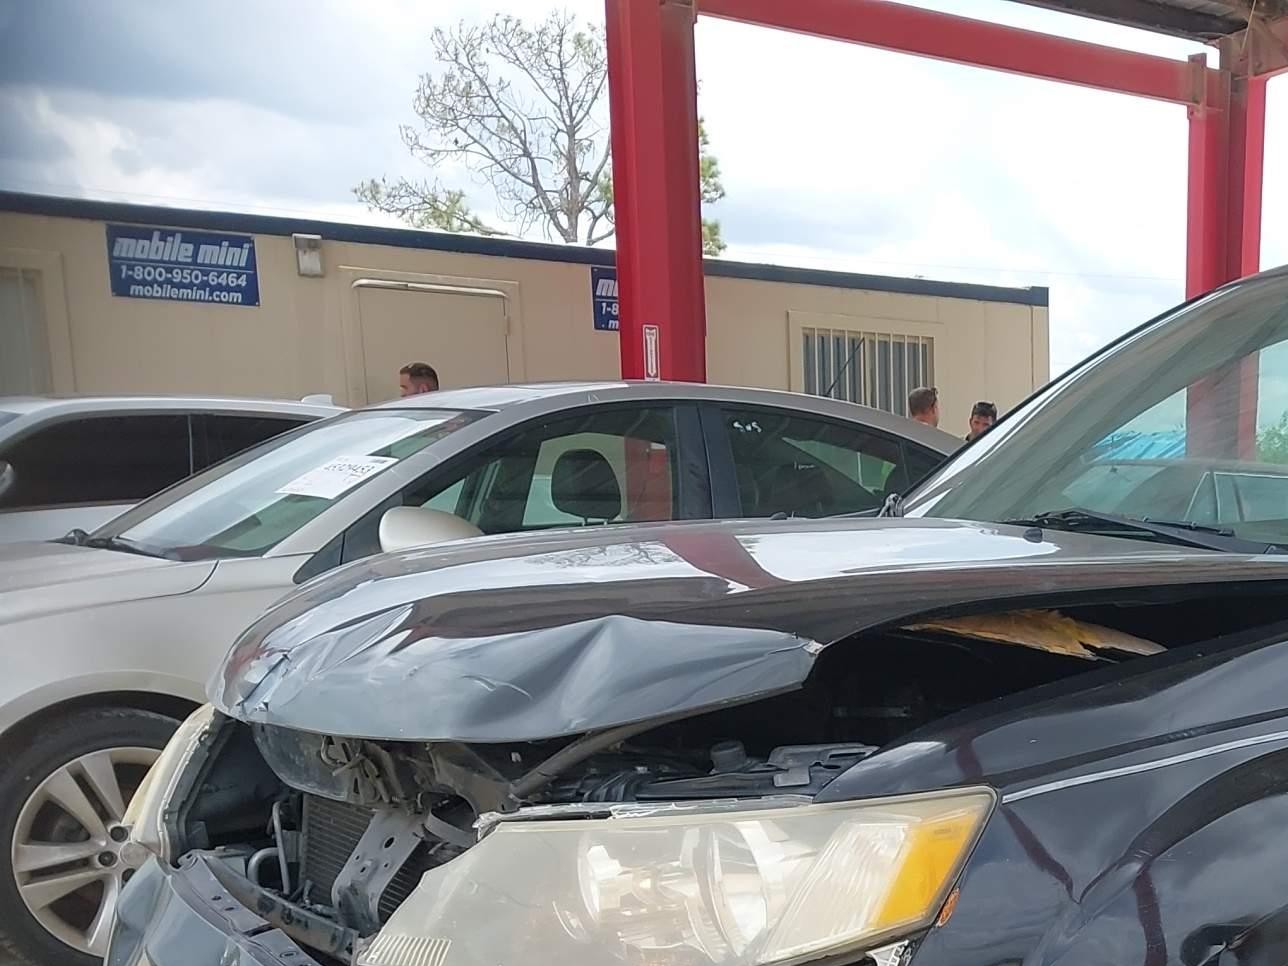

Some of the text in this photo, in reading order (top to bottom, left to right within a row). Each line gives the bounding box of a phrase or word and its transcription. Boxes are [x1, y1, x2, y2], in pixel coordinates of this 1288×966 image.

[113, 231, 250, 267] mobile mini
[120, 265, 247, 287] 1-800-950-6464
[130, 283, 242, 303] mobilemini.com
